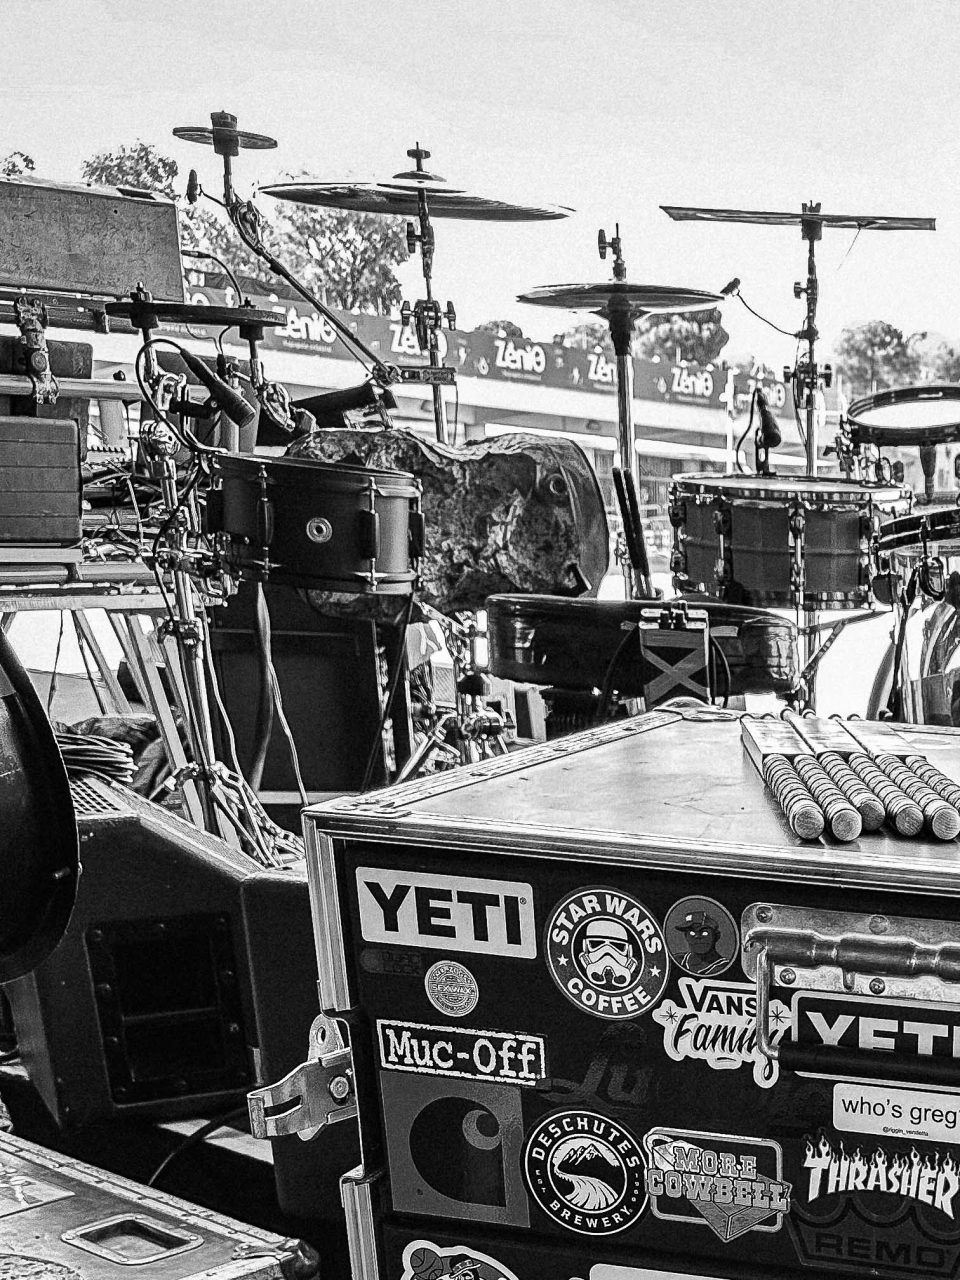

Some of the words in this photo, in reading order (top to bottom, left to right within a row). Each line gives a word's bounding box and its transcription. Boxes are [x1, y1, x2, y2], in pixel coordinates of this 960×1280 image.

[363, 881, 522, 945] YETI
[552, 894, 601, 946] STAR
[605, 894, 661, 954] WARS
[567, 977, 651, 1013] COFFEE
[686, 984, 758, 1018] VANS
[386, 1029, 537, 1079] Muc-Off
[842, 1098, 903, 1119] who's
[532, 1117, 640, 1167] DESCHUTES
[673, 1147, 757, 1180] MORE
[804, 1138, 960, 1219] THRASHER
[648, 1168, 790, 1211] COWBELL
[550, 1200, 631, 1228] BREWERY
[815, 1233, 945, 1267] REMO
